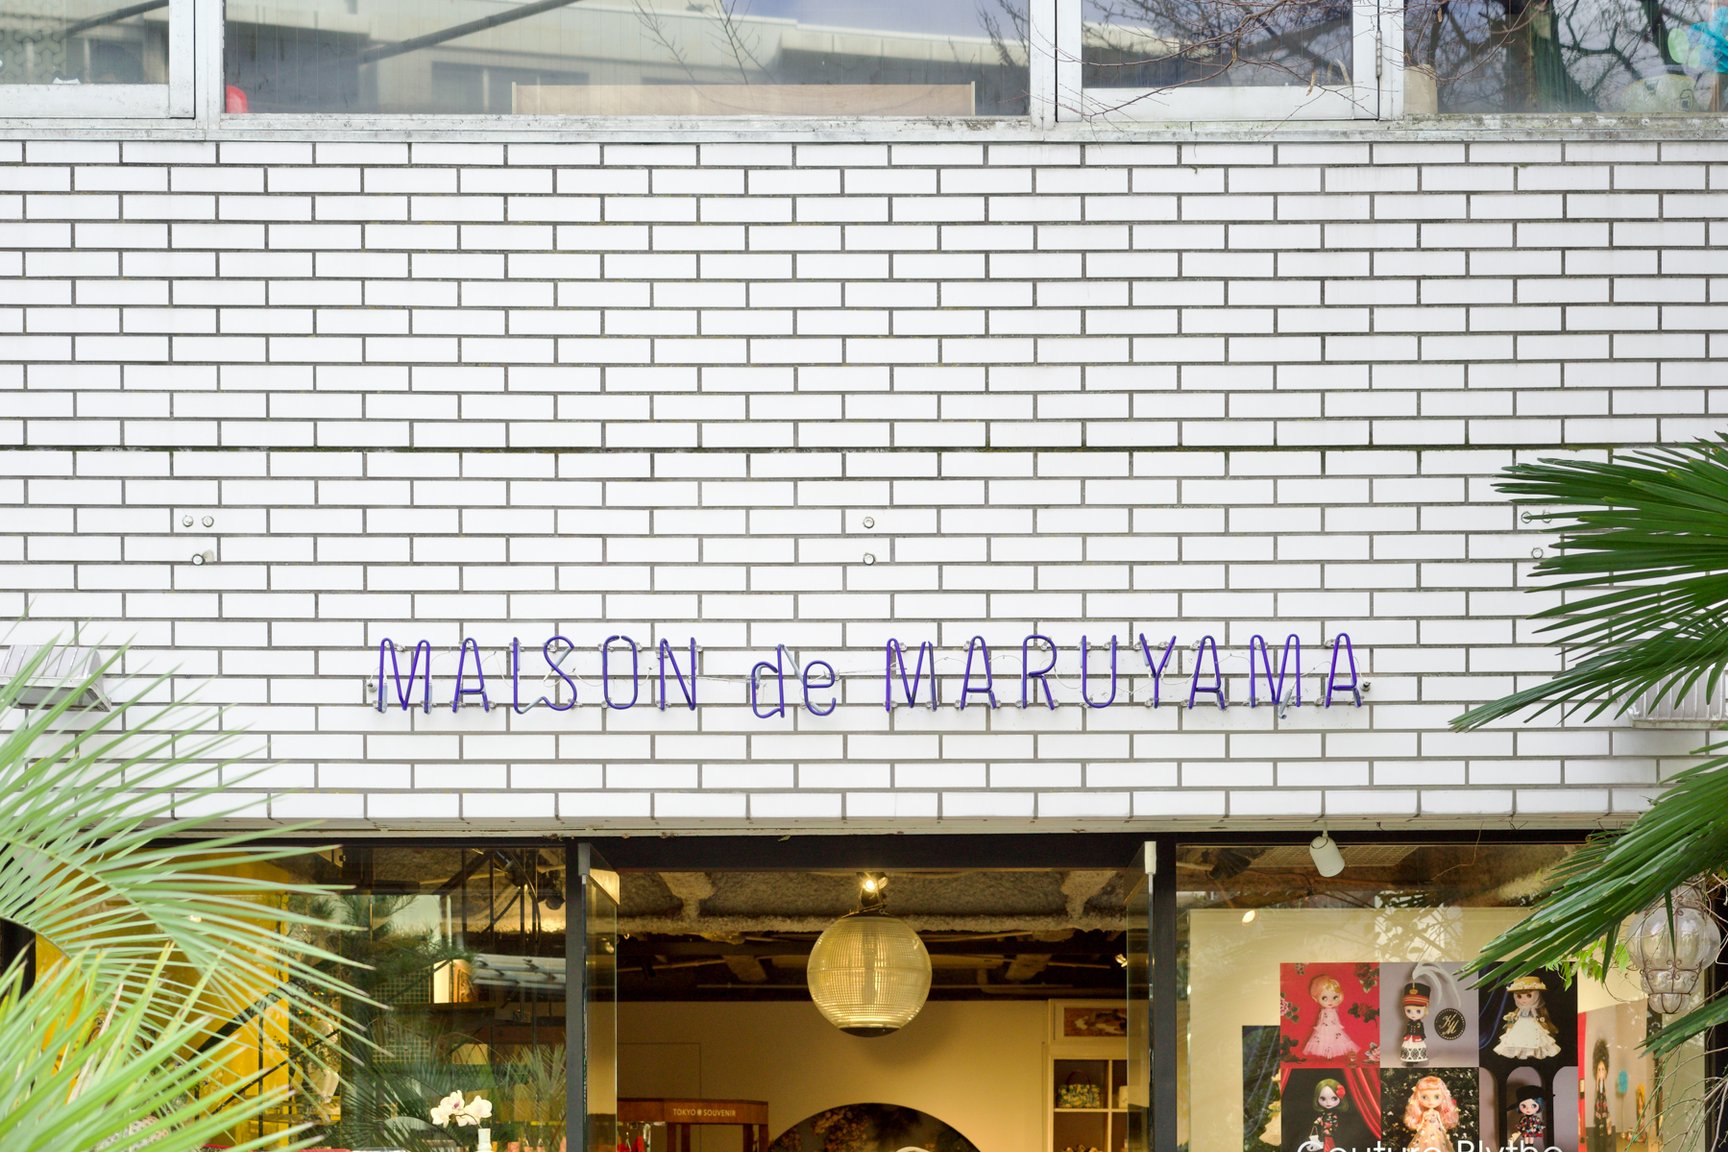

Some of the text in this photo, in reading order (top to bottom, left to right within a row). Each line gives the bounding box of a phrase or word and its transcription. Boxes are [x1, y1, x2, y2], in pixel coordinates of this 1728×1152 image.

[377, 633, 1362, 718] MAISON de MARUYAMA
[673, 1108, 736, 1117] TOKYO SOUVENIR
